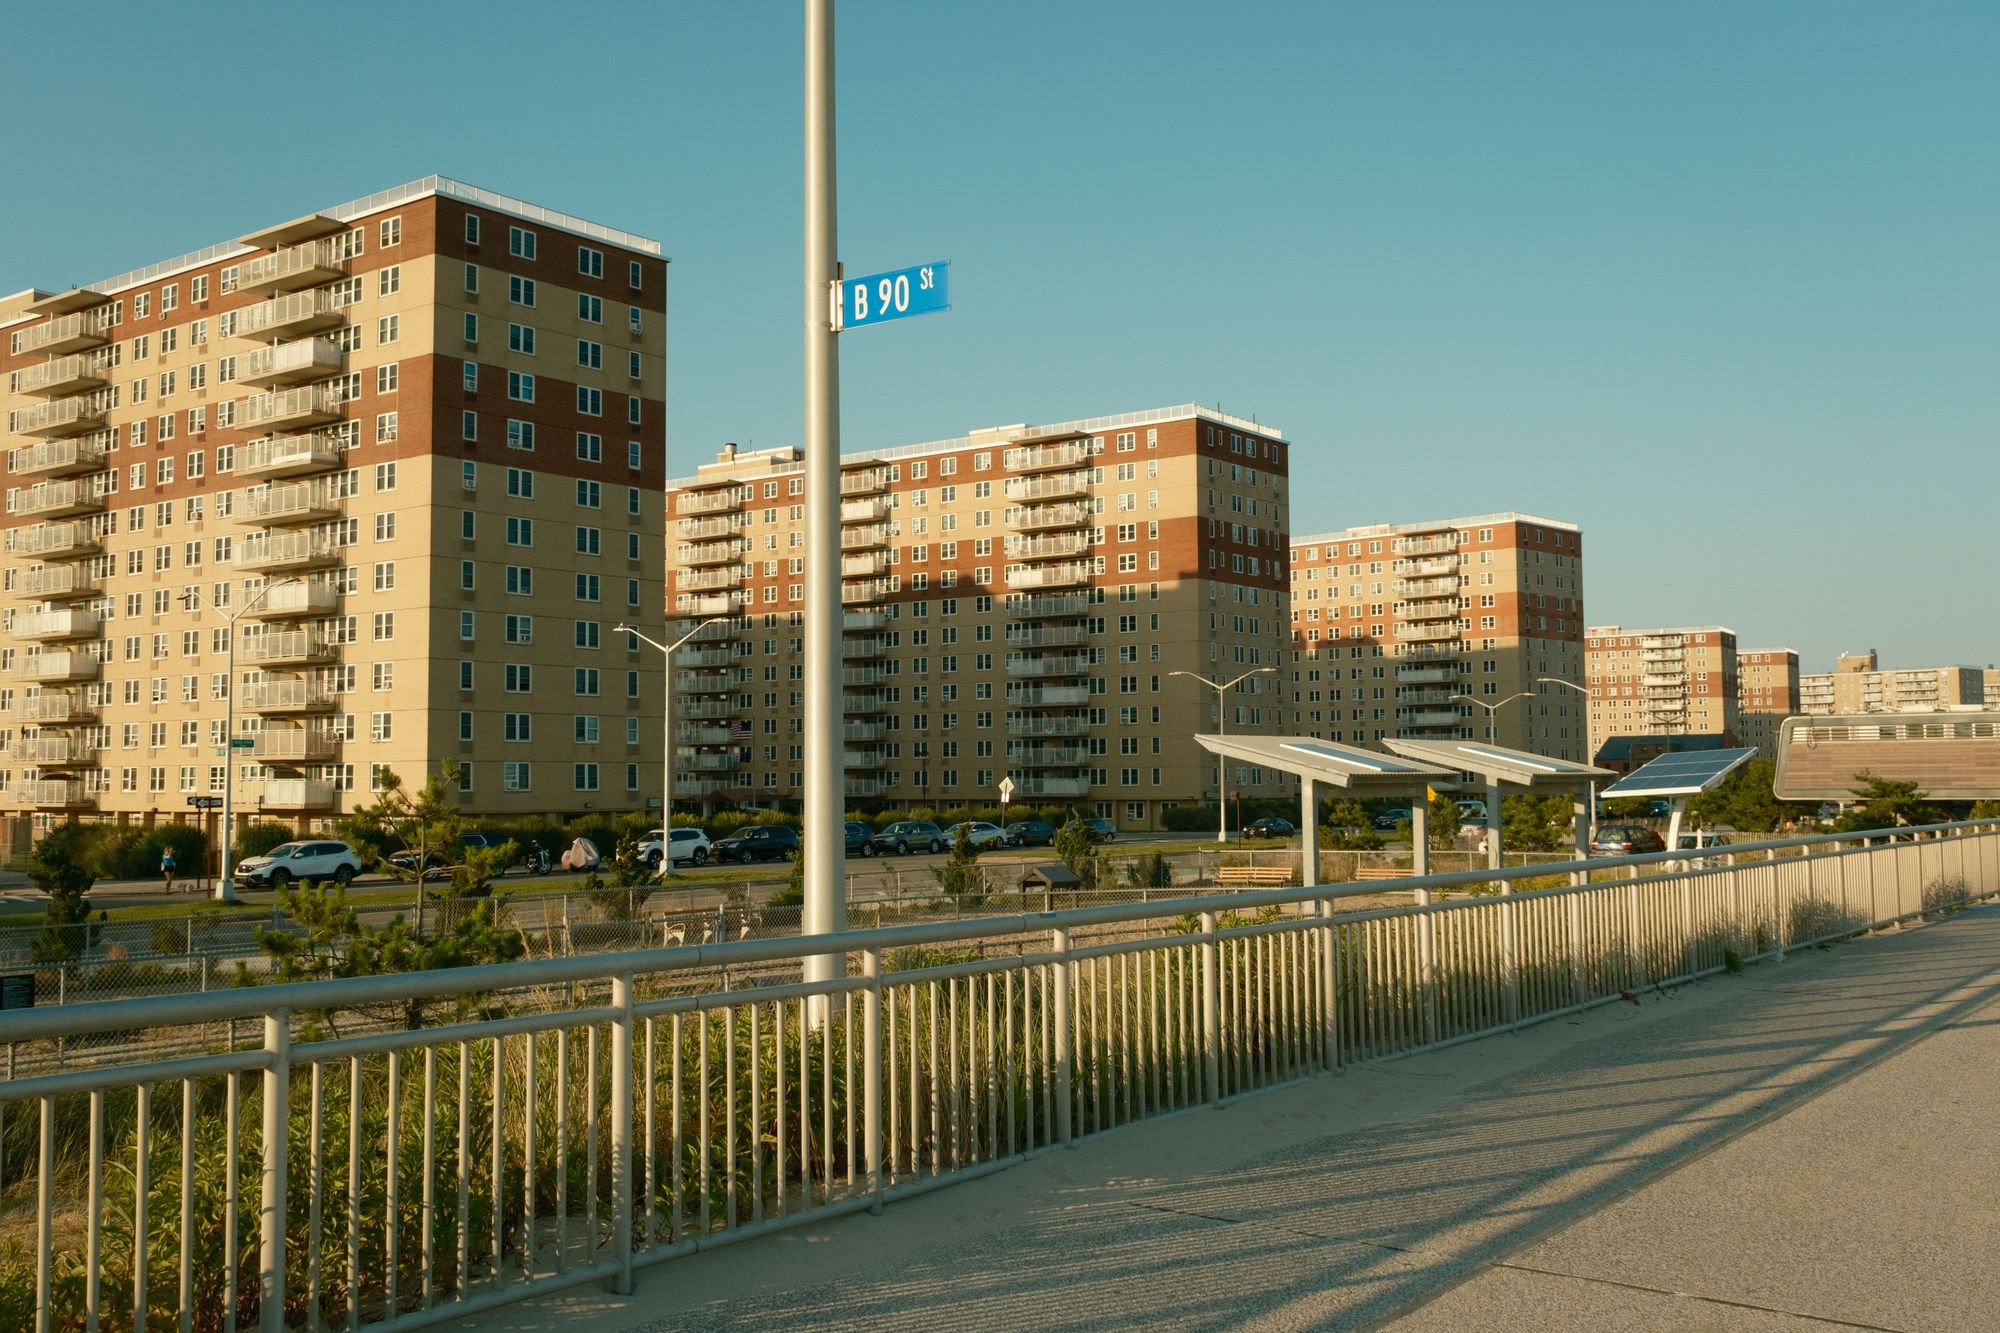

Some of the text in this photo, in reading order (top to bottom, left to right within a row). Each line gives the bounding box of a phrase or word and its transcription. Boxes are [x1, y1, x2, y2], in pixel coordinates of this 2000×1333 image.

[855, 267, 934, 320] B 90 St
